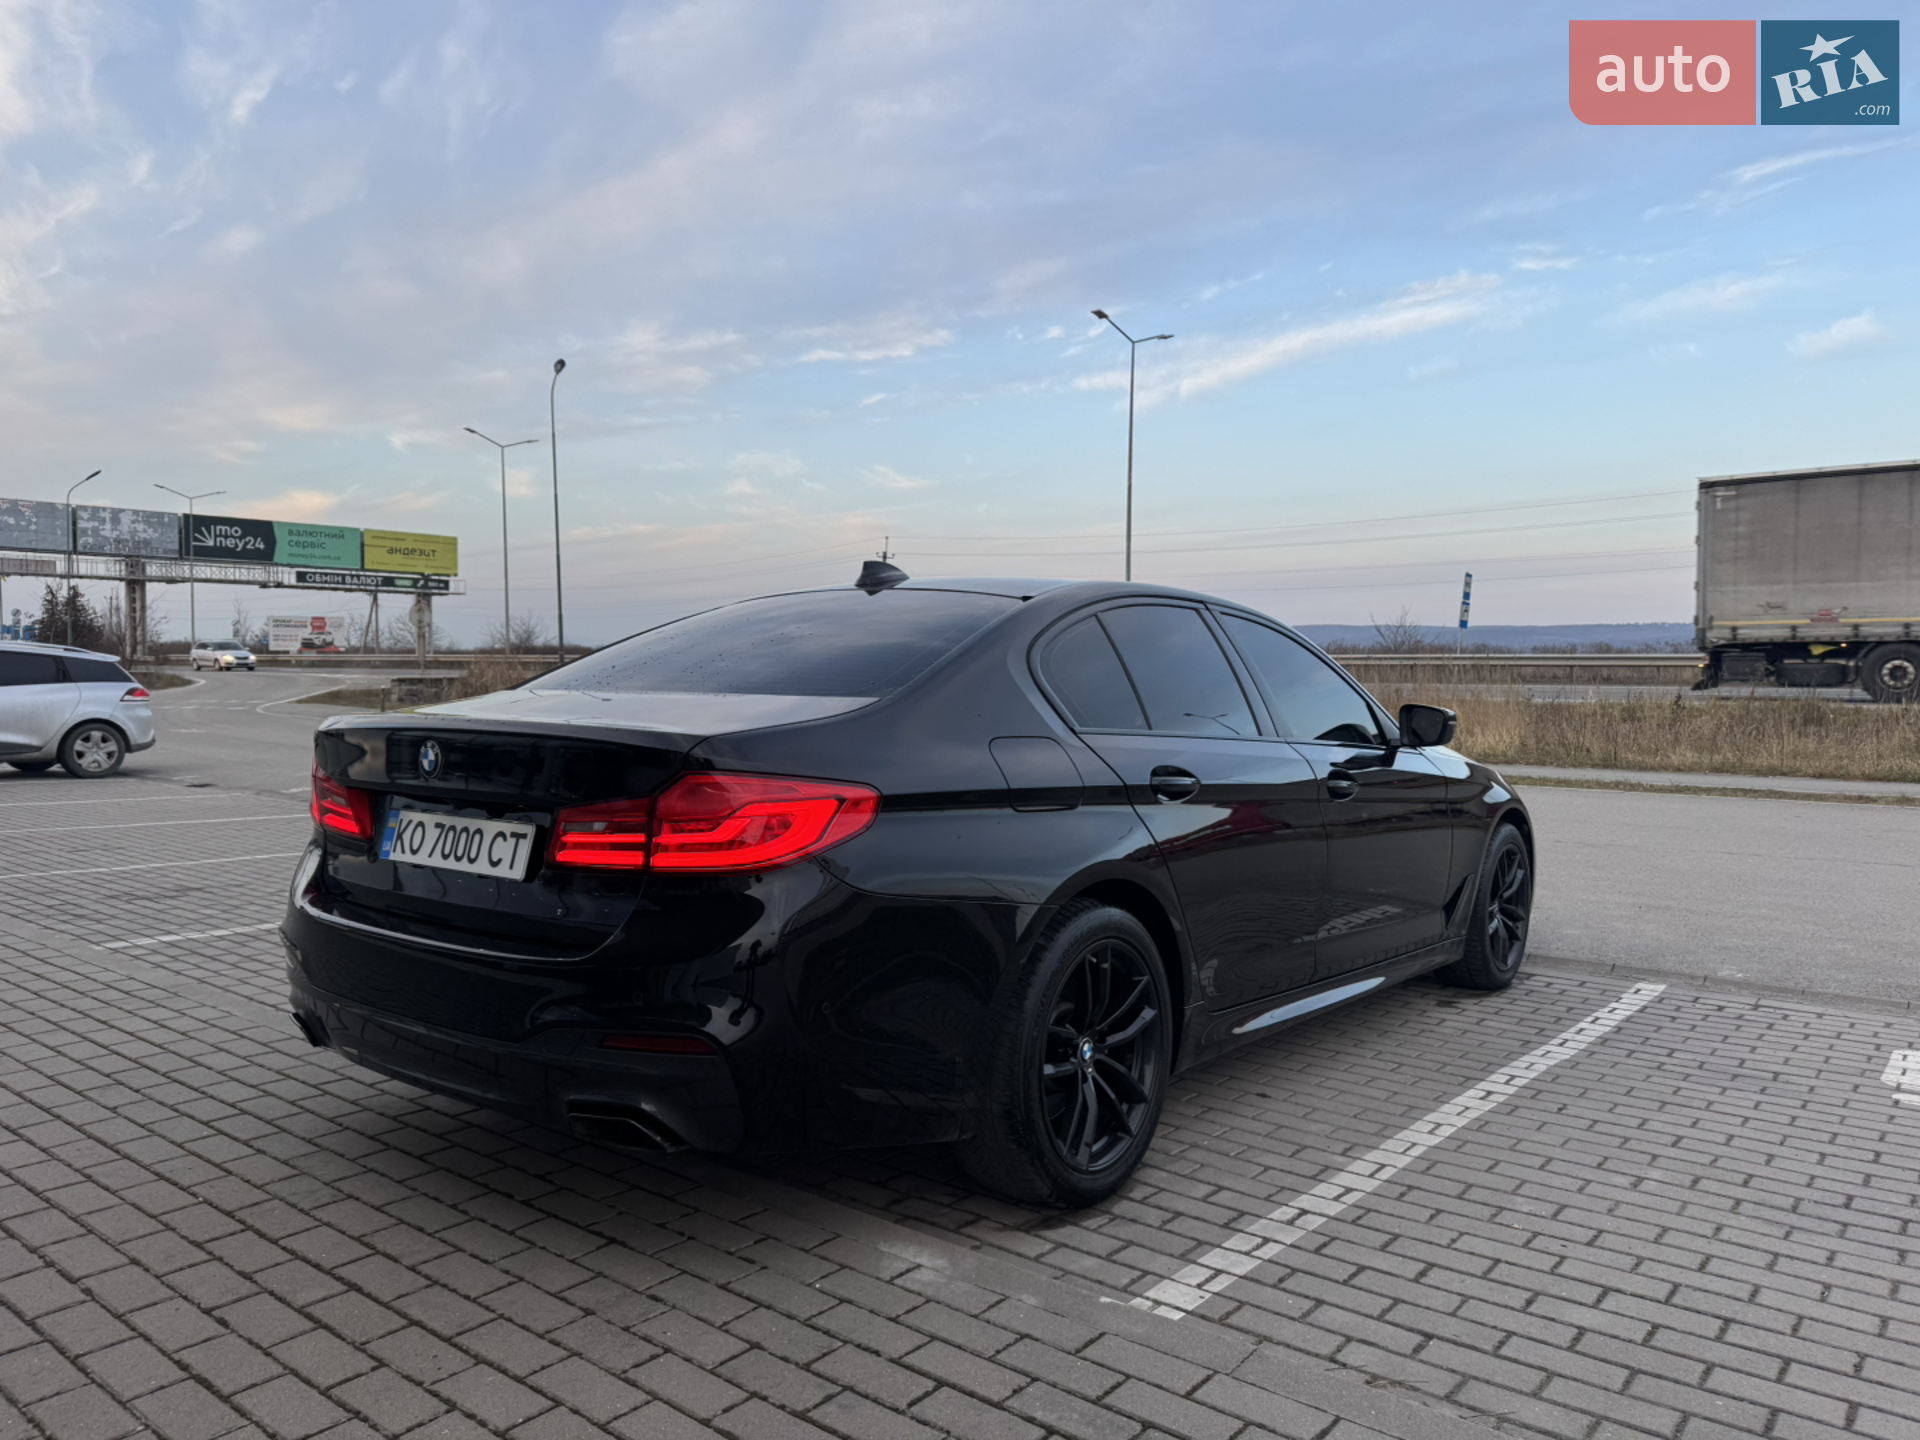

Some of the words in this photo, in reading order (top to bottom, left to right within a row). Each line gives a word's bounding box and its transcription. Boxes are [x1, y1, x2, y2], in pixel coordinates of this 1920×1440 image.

[216, 524, 243, 538] mo
[287, 528, 345, 541] валютний
[216, 536, 265, 552] ney24
[287, 538, 327, 551] сервіс
[306, 573, 342, 584] ОБМІН
[345, 576, 384, 587] ВАЛЮТ
[392, 818, 426, 856] KO
[428, 821, 484, 865] 7000
[488, 830, 528, 871] CT
